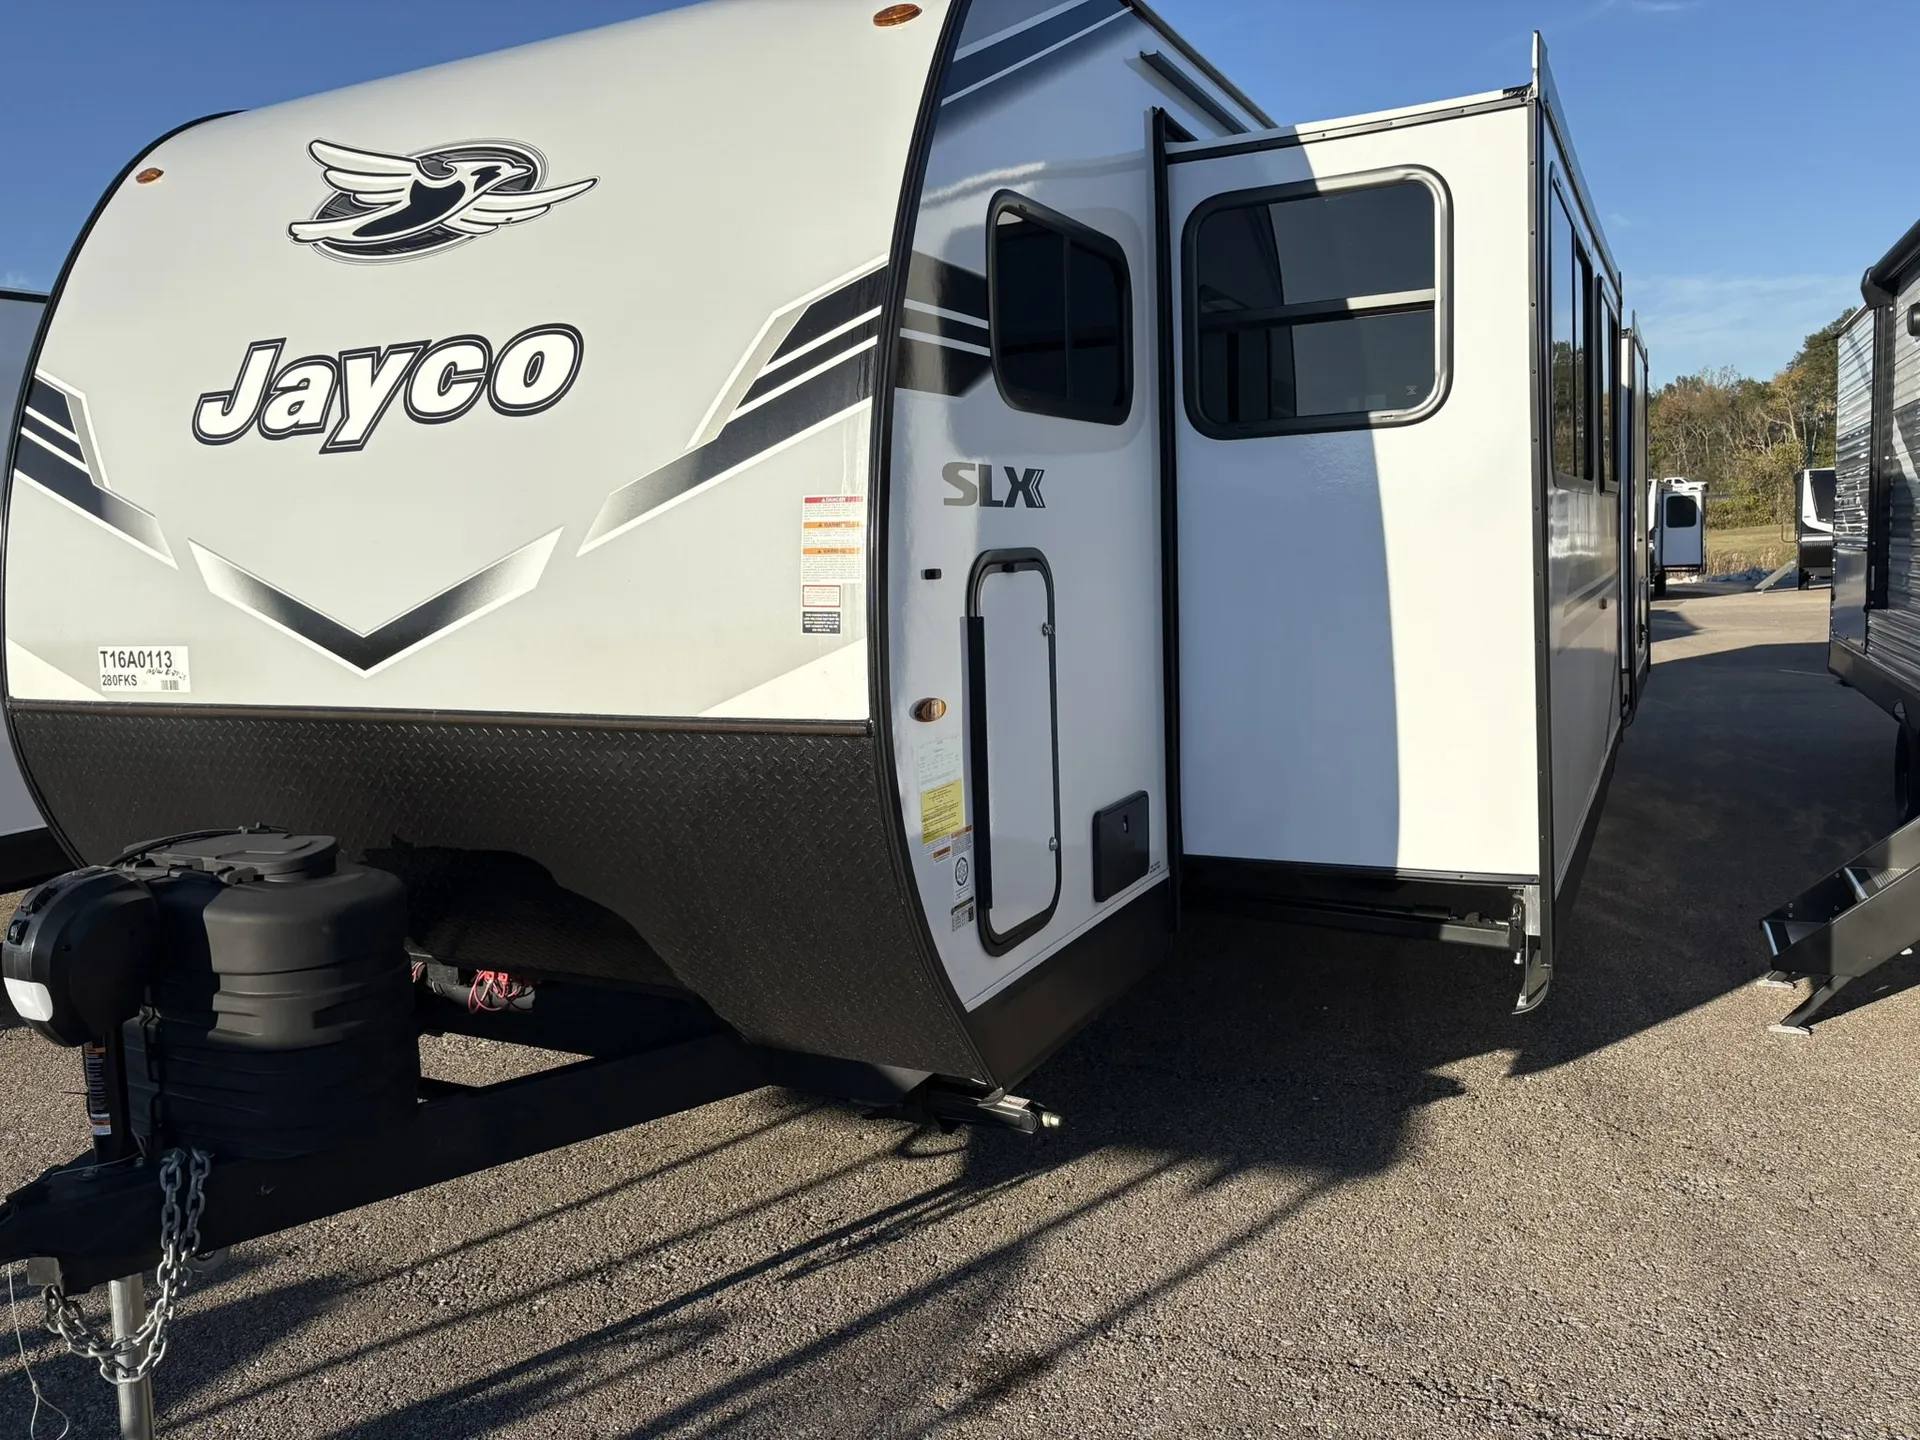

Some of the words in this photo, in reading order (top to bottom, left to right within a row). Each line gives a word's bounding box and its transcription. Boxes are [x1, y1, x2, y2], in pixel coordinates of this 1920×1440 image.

[192, 323, 584, 454] Jayco
[942, 462, 1046, 508] SLX
[100, 650, 173, 669] T16A0113
[101, 674, 138, 686] 280FKS
